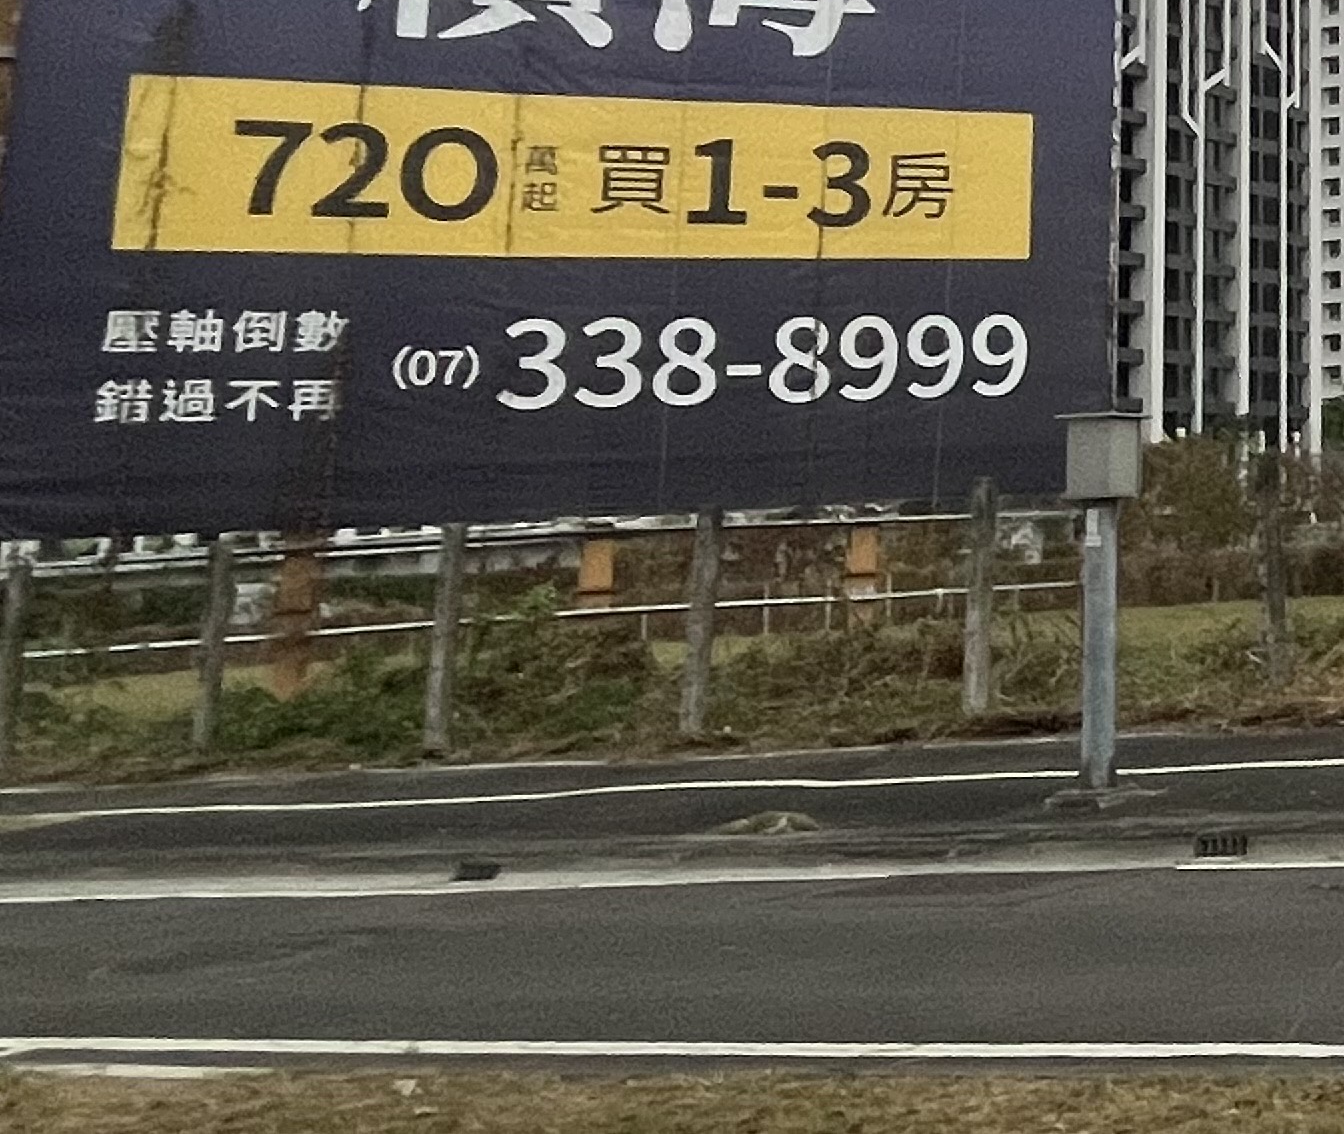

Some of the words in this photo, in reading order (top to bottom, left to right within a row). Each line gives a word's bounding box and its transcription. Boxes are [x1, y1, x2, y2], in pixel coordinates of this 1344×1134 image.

[234, 119, 499, 222] 720
[100, 309, 351, 354] 壓軸倒數
[392, 345, 481, 391] (07)
[496, 313, 1029, 410] 338-8999
[93, 378, 342, 423] 錯過不再
